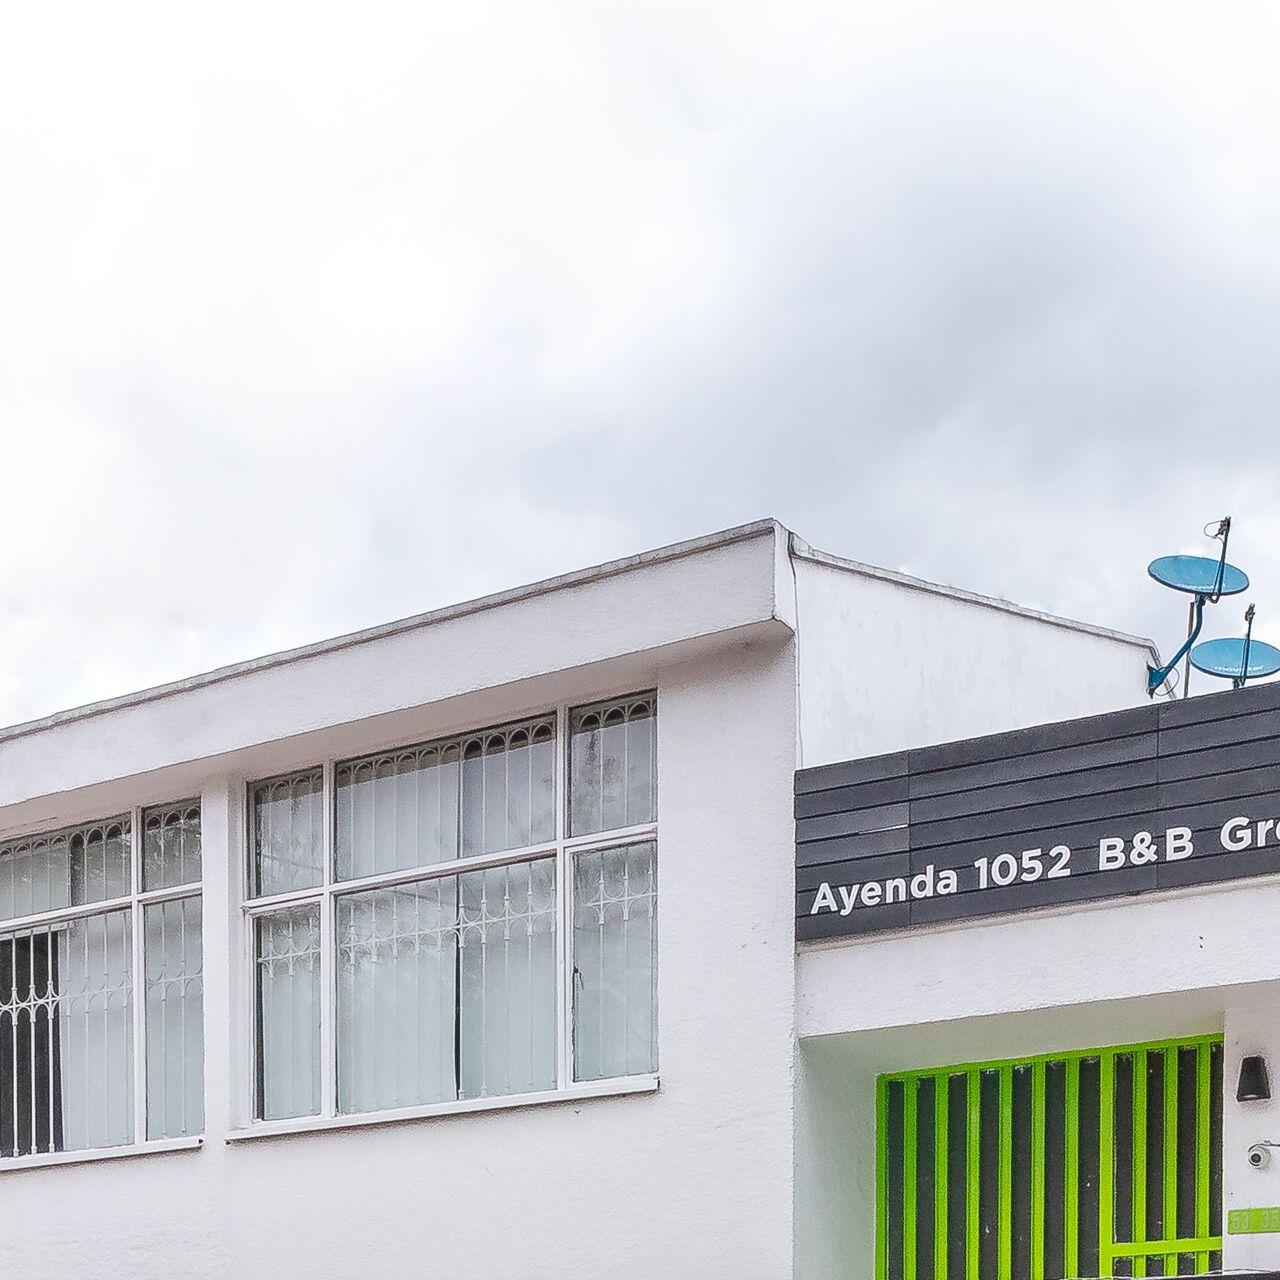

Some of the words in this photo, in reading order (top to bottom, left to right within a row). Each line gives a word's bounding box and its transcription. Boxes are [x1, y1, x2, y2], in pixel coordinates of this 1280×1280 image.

[810, 865, 958, 917] Ayenda
[974, 844, 1072, 890] 1052
[1098, 826, 1194, 872] B&B
